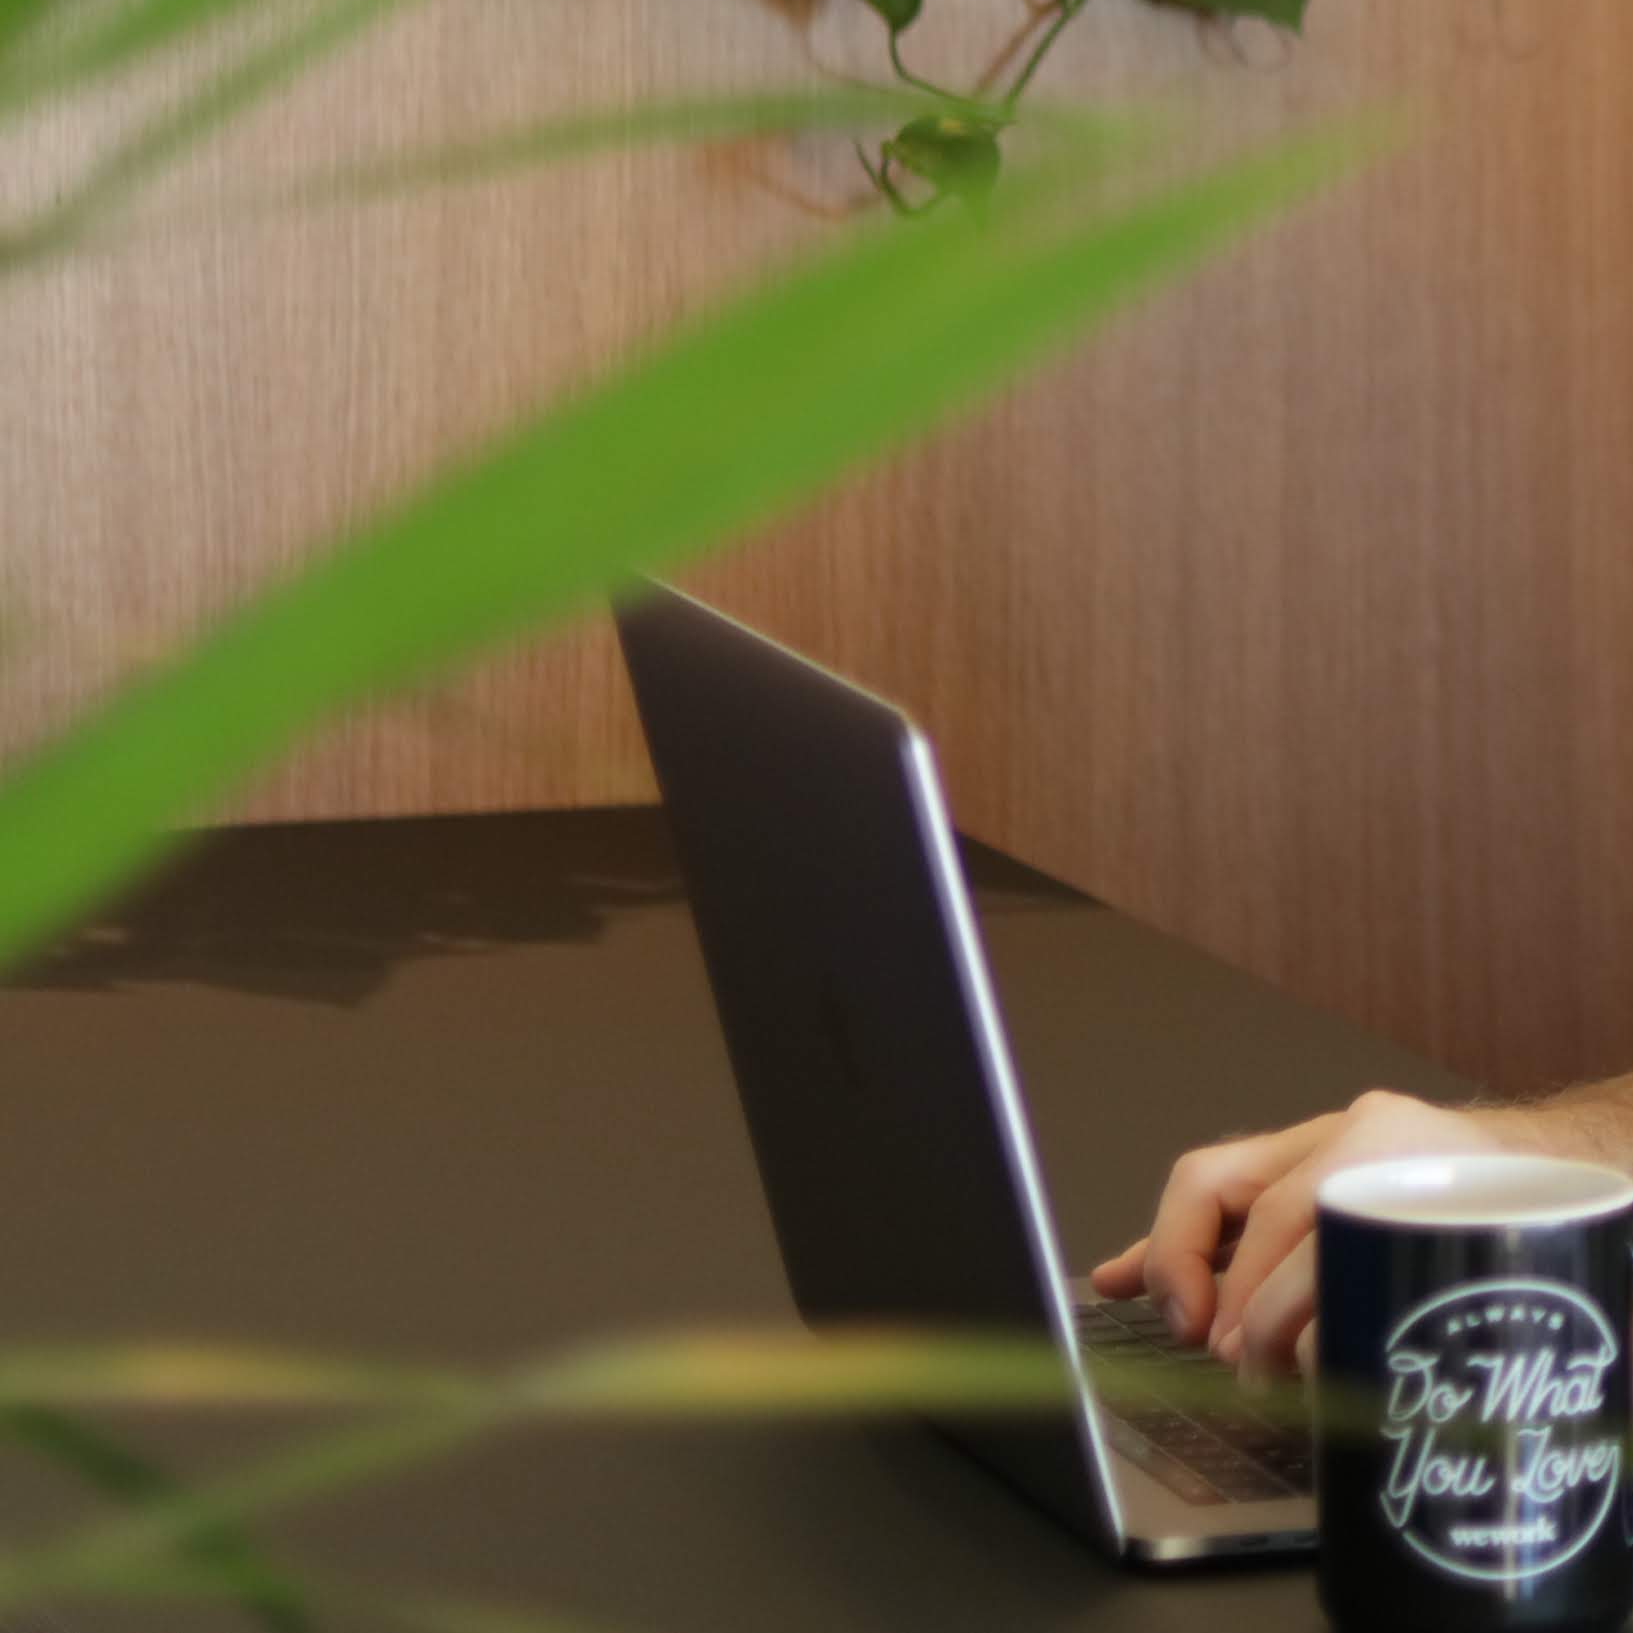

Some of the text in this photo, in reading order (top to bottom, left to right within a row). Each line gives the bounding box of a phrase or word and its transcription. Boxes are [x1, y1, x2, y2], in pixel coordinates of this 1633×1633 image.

[1387, 1346, 1617, 1423] Do What
[1380, 1425, 1620, 1528] You Love
